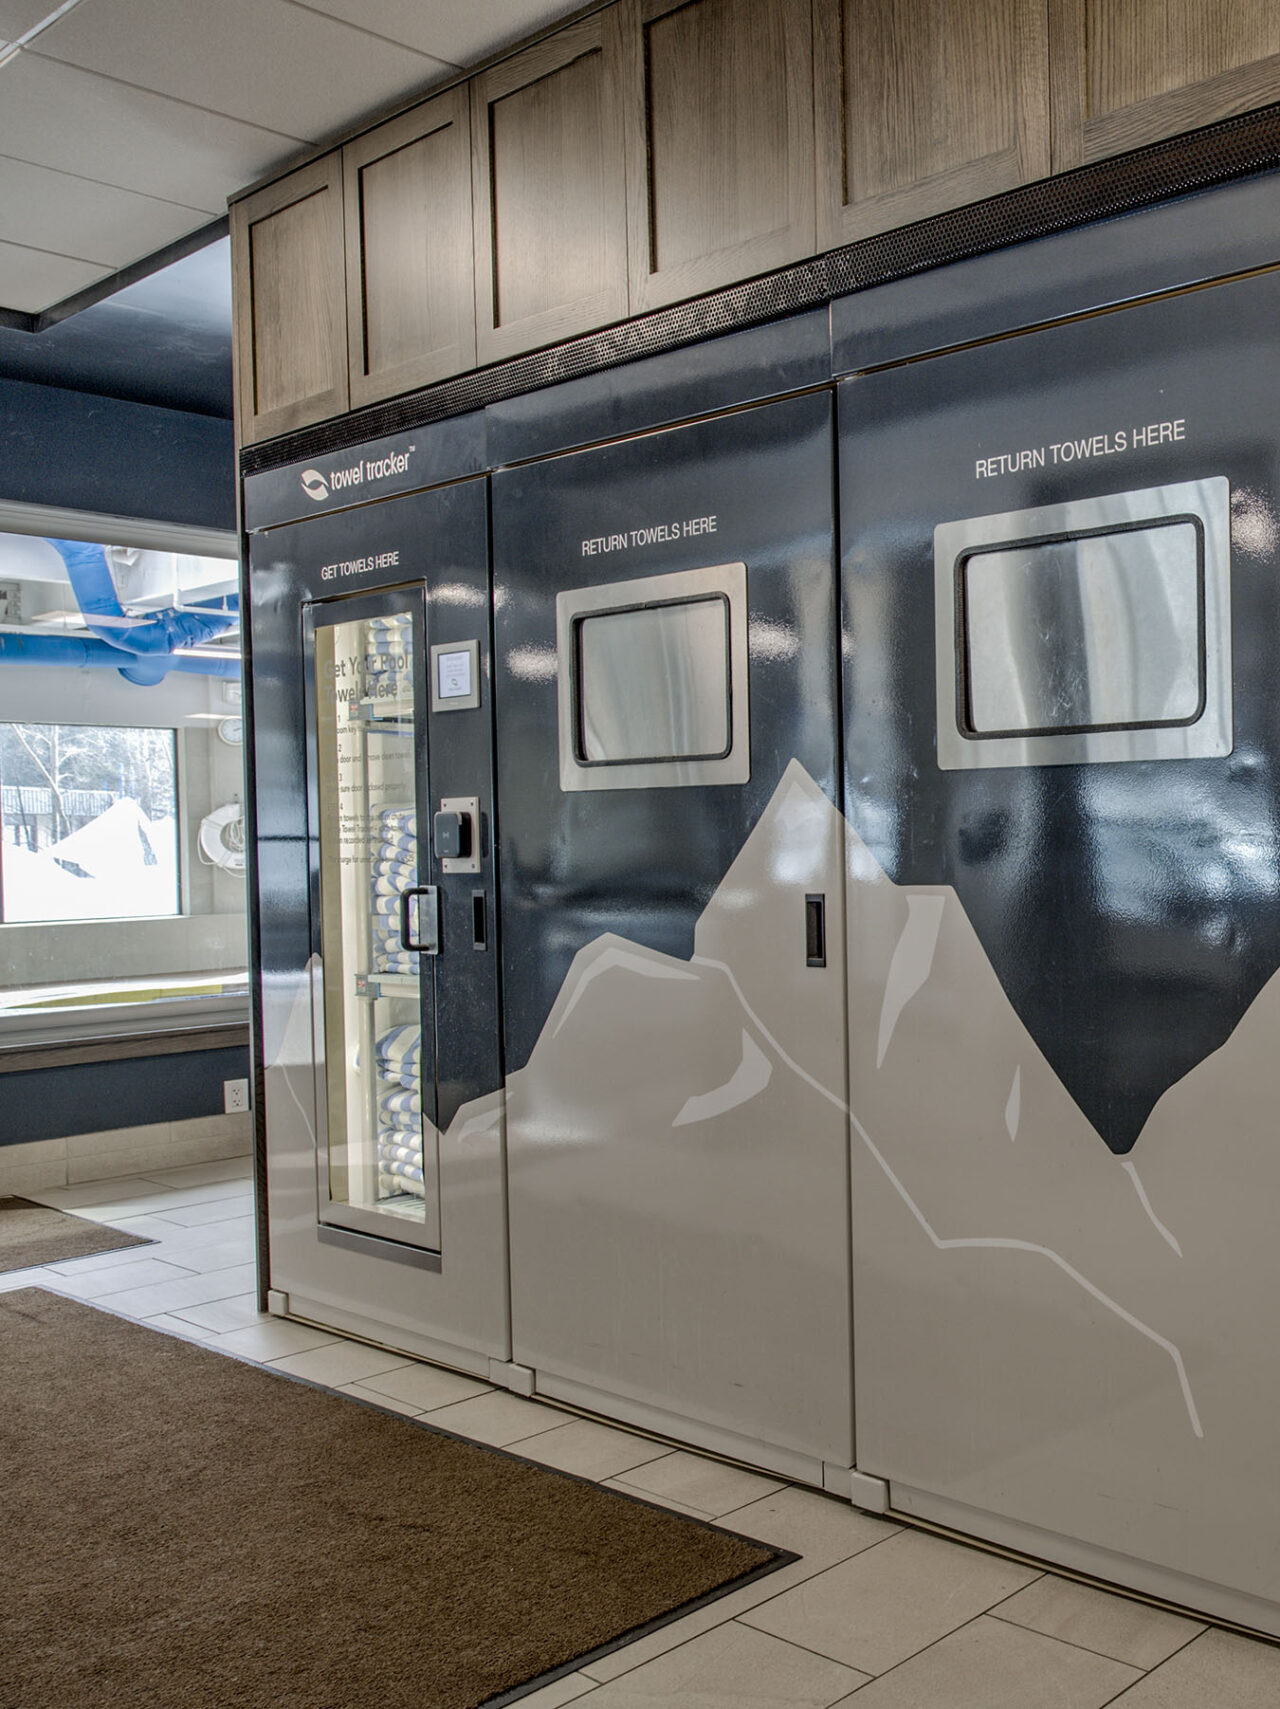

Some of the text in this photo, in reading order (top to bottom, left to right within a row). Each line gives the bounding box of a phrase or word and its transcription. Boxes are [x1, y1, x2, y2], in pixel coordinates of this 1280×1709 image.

[975, 419, 1186, 479] RETURN TOWELS HERE
[330, 460, 363, 490] towel
[581, 515, 717, 557] RETURN TOWELS HERE
[321, 551, 399, 580] GET TOWELS HERE
[380, 653, 408, 672] Pool
